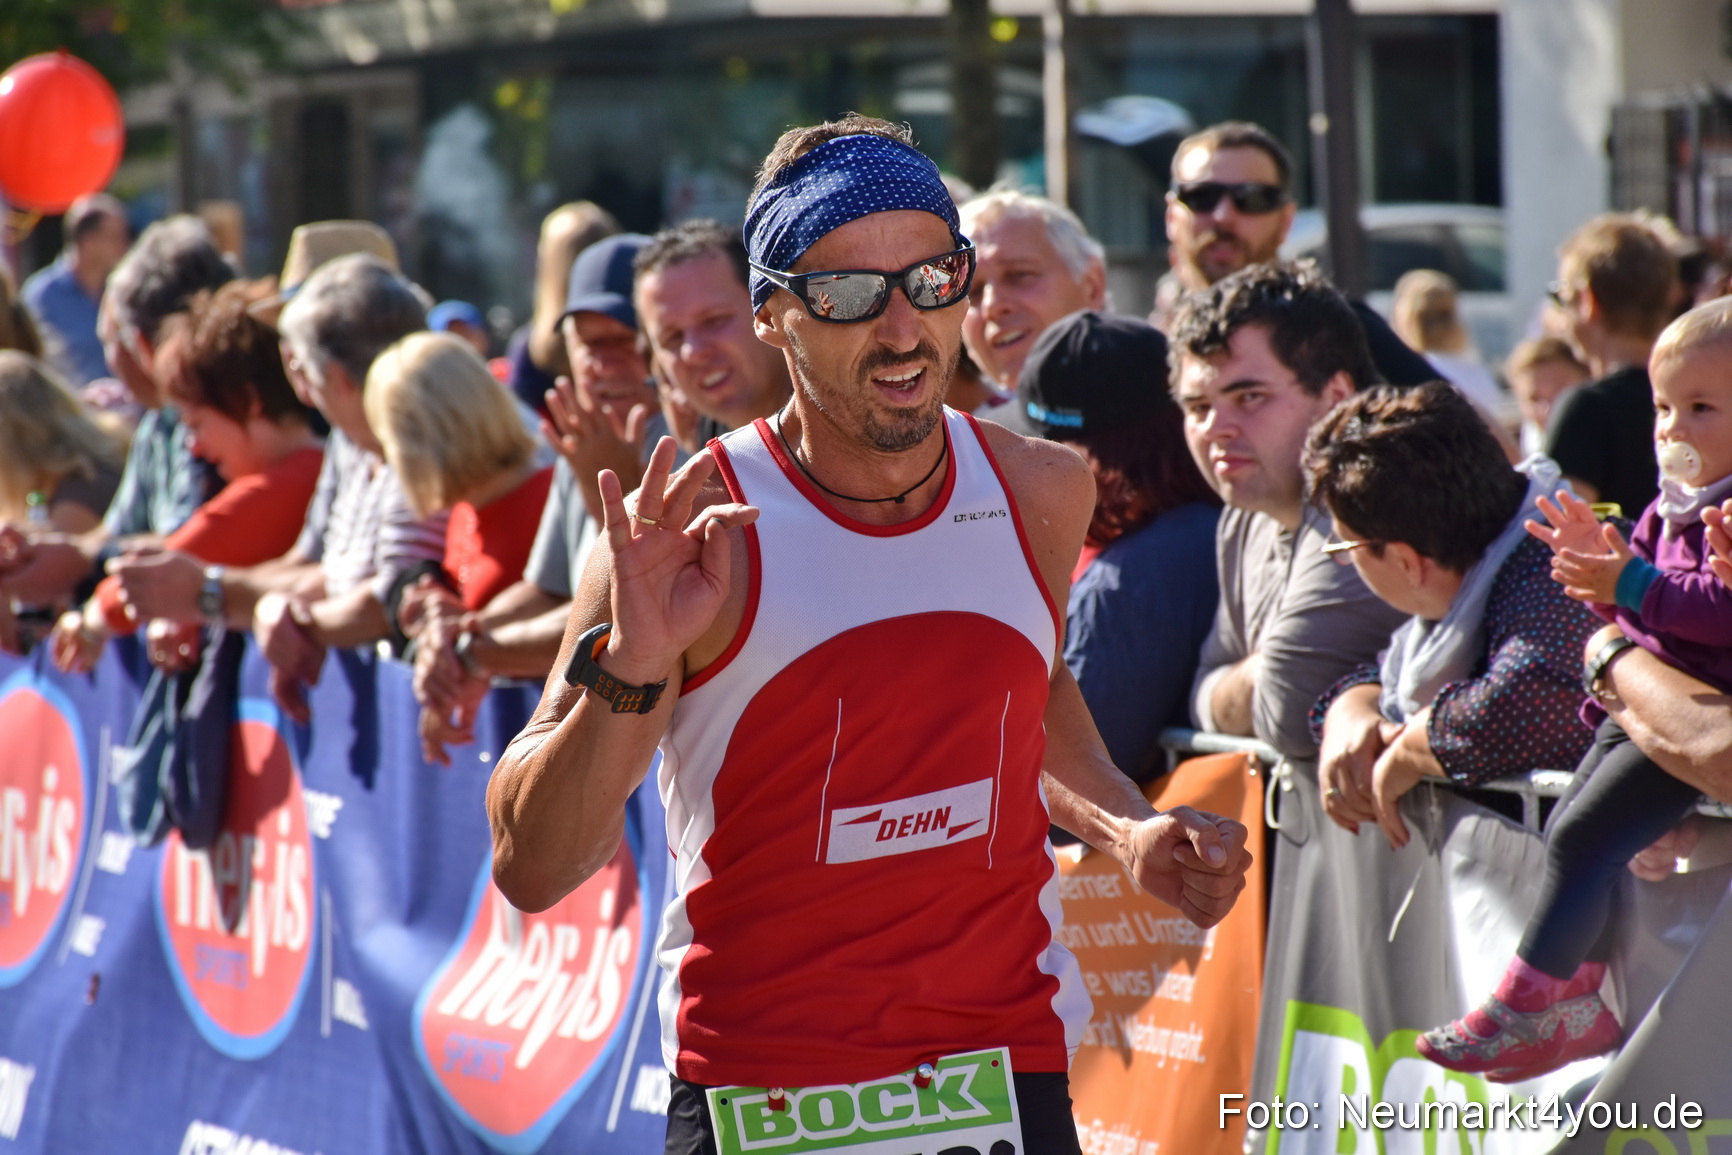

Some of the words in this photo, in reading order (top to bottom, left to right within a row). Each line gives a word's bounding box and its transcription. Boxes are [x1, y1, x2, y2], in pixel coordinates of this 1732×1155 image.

[875, 805, 952, 843] DEHN
[1088, 911, 1137, 948] und
[732, 1063, 993, 1152] BOCK
